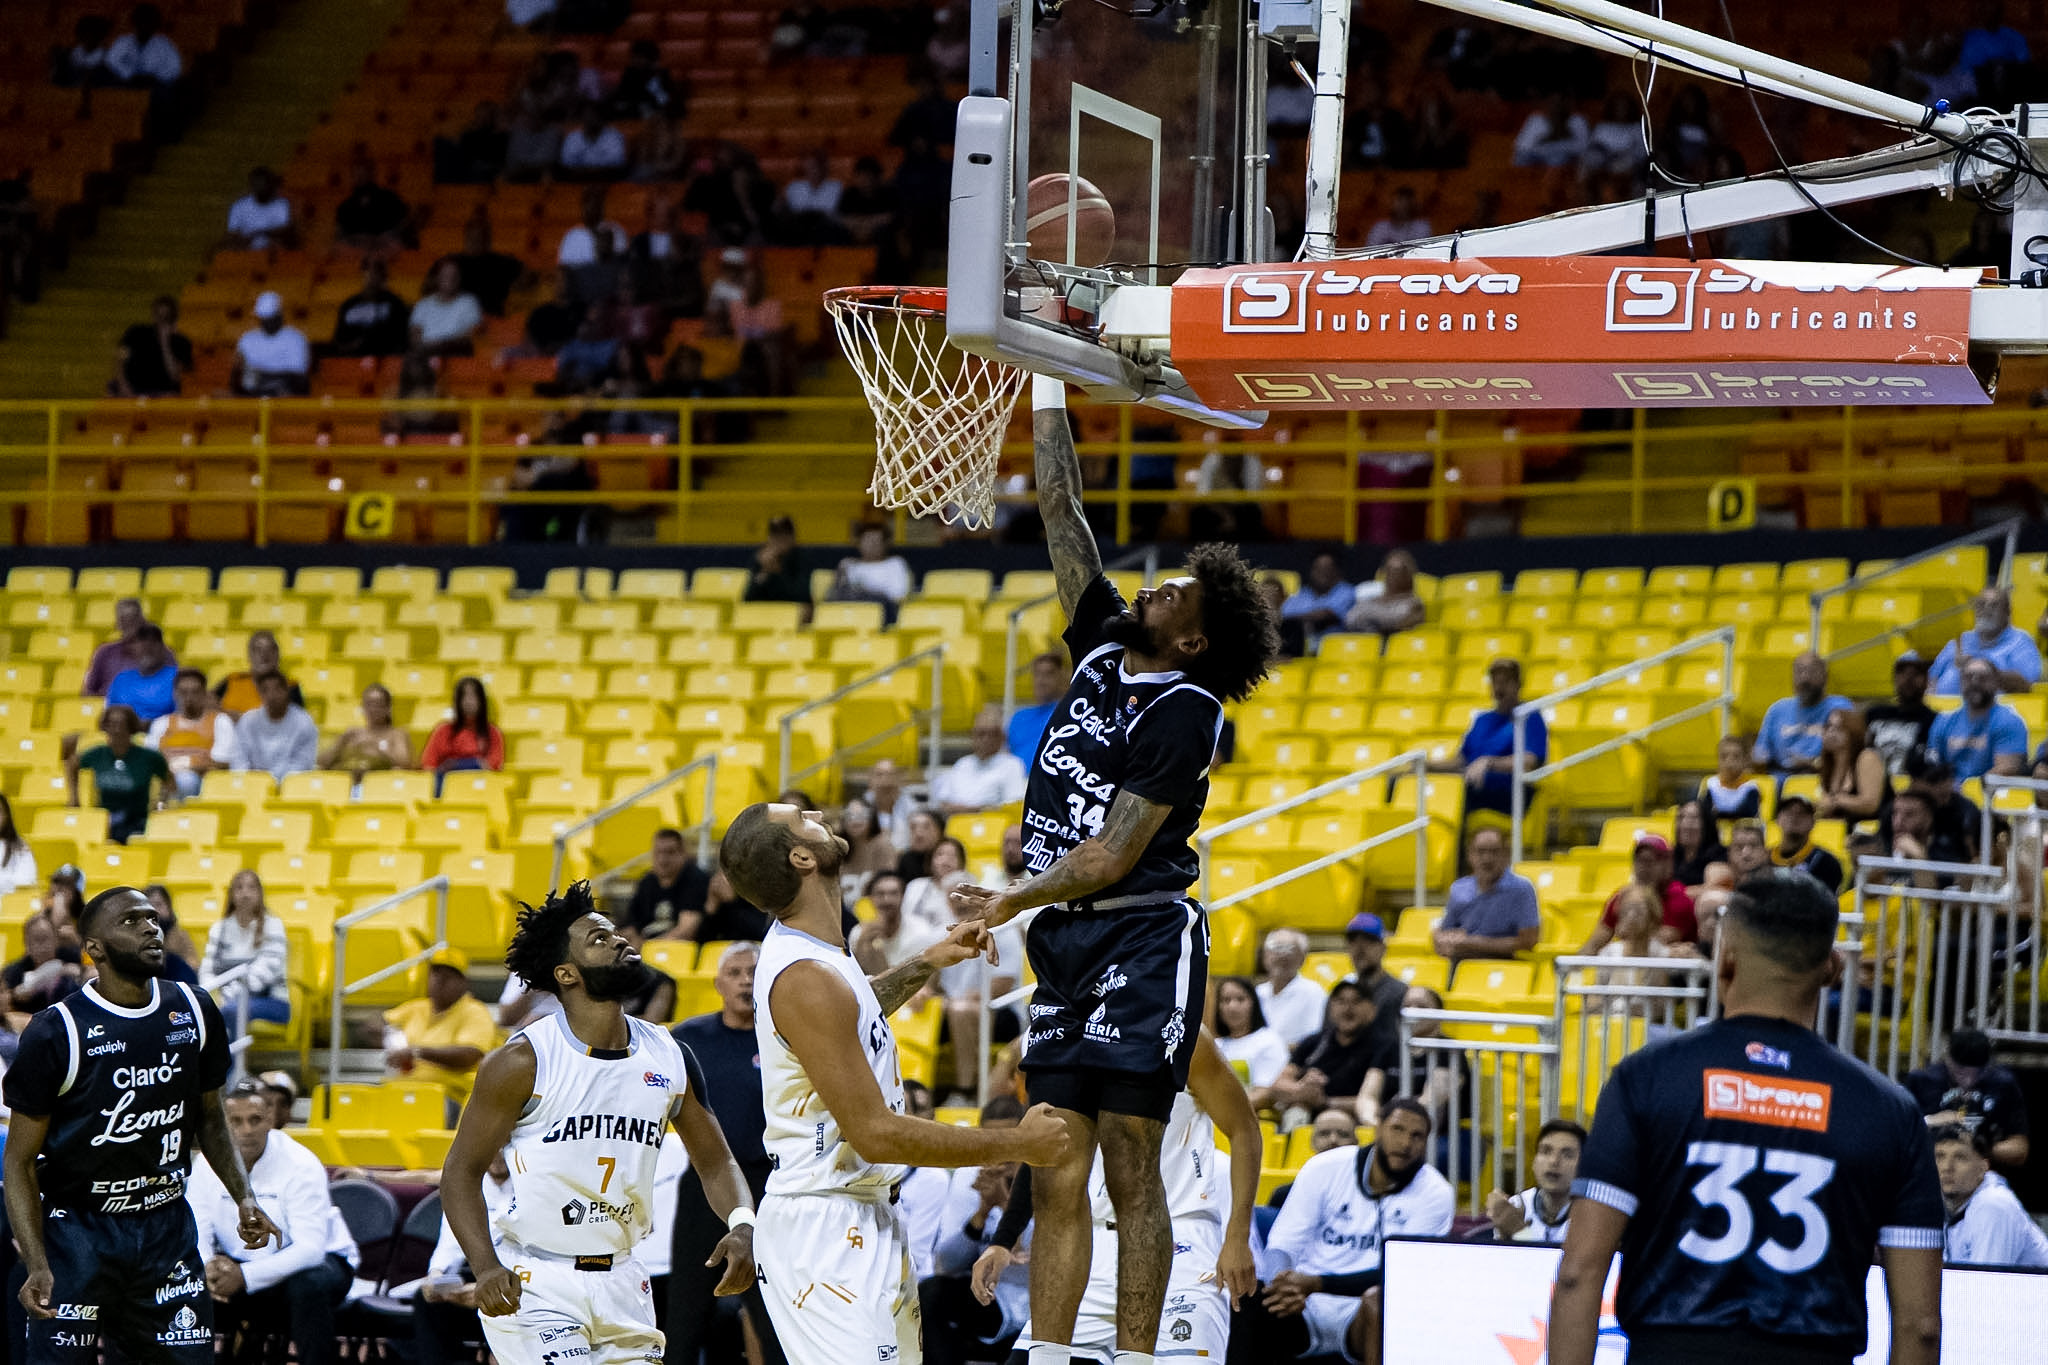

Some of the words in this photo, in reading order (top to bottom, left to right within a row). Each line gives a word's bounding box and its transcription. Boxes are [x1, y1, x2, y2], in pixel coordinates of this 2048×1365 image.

[1315, 270, 1521, 295] brava
[1316, 308, 1519, 332] lubricants
[1703, 306, 1918, 330] lubricants
[1325, 372, 1534, 390] brava
[1709, 371, 1928, 388] brava
[1341, 392, 1544, 402] lubricants
[1722, 389, 1936, 400] lubricants
[357, 499, 383, 530] C
[1721, 487, 1744, 522] D
[1039, 724, 1116, 803] Leones
[1024, 807, 1085, 843] ECOMA
[1066, 793, 1106, 837] 34
[86, 1040, 127, 1057] equiply
[112, 1064, 173, 1089] Claro
[90, 1089, 184, 1147] Leones
[159, 1128, 182, 1166] 19
[596, 1156, 617, 1194] 7
[1677, 1140, 1837, 1275] 33
[155, 1276, 205, 1305] Wendy's
[156, 1325, 212, 1341] LOTERÍA
